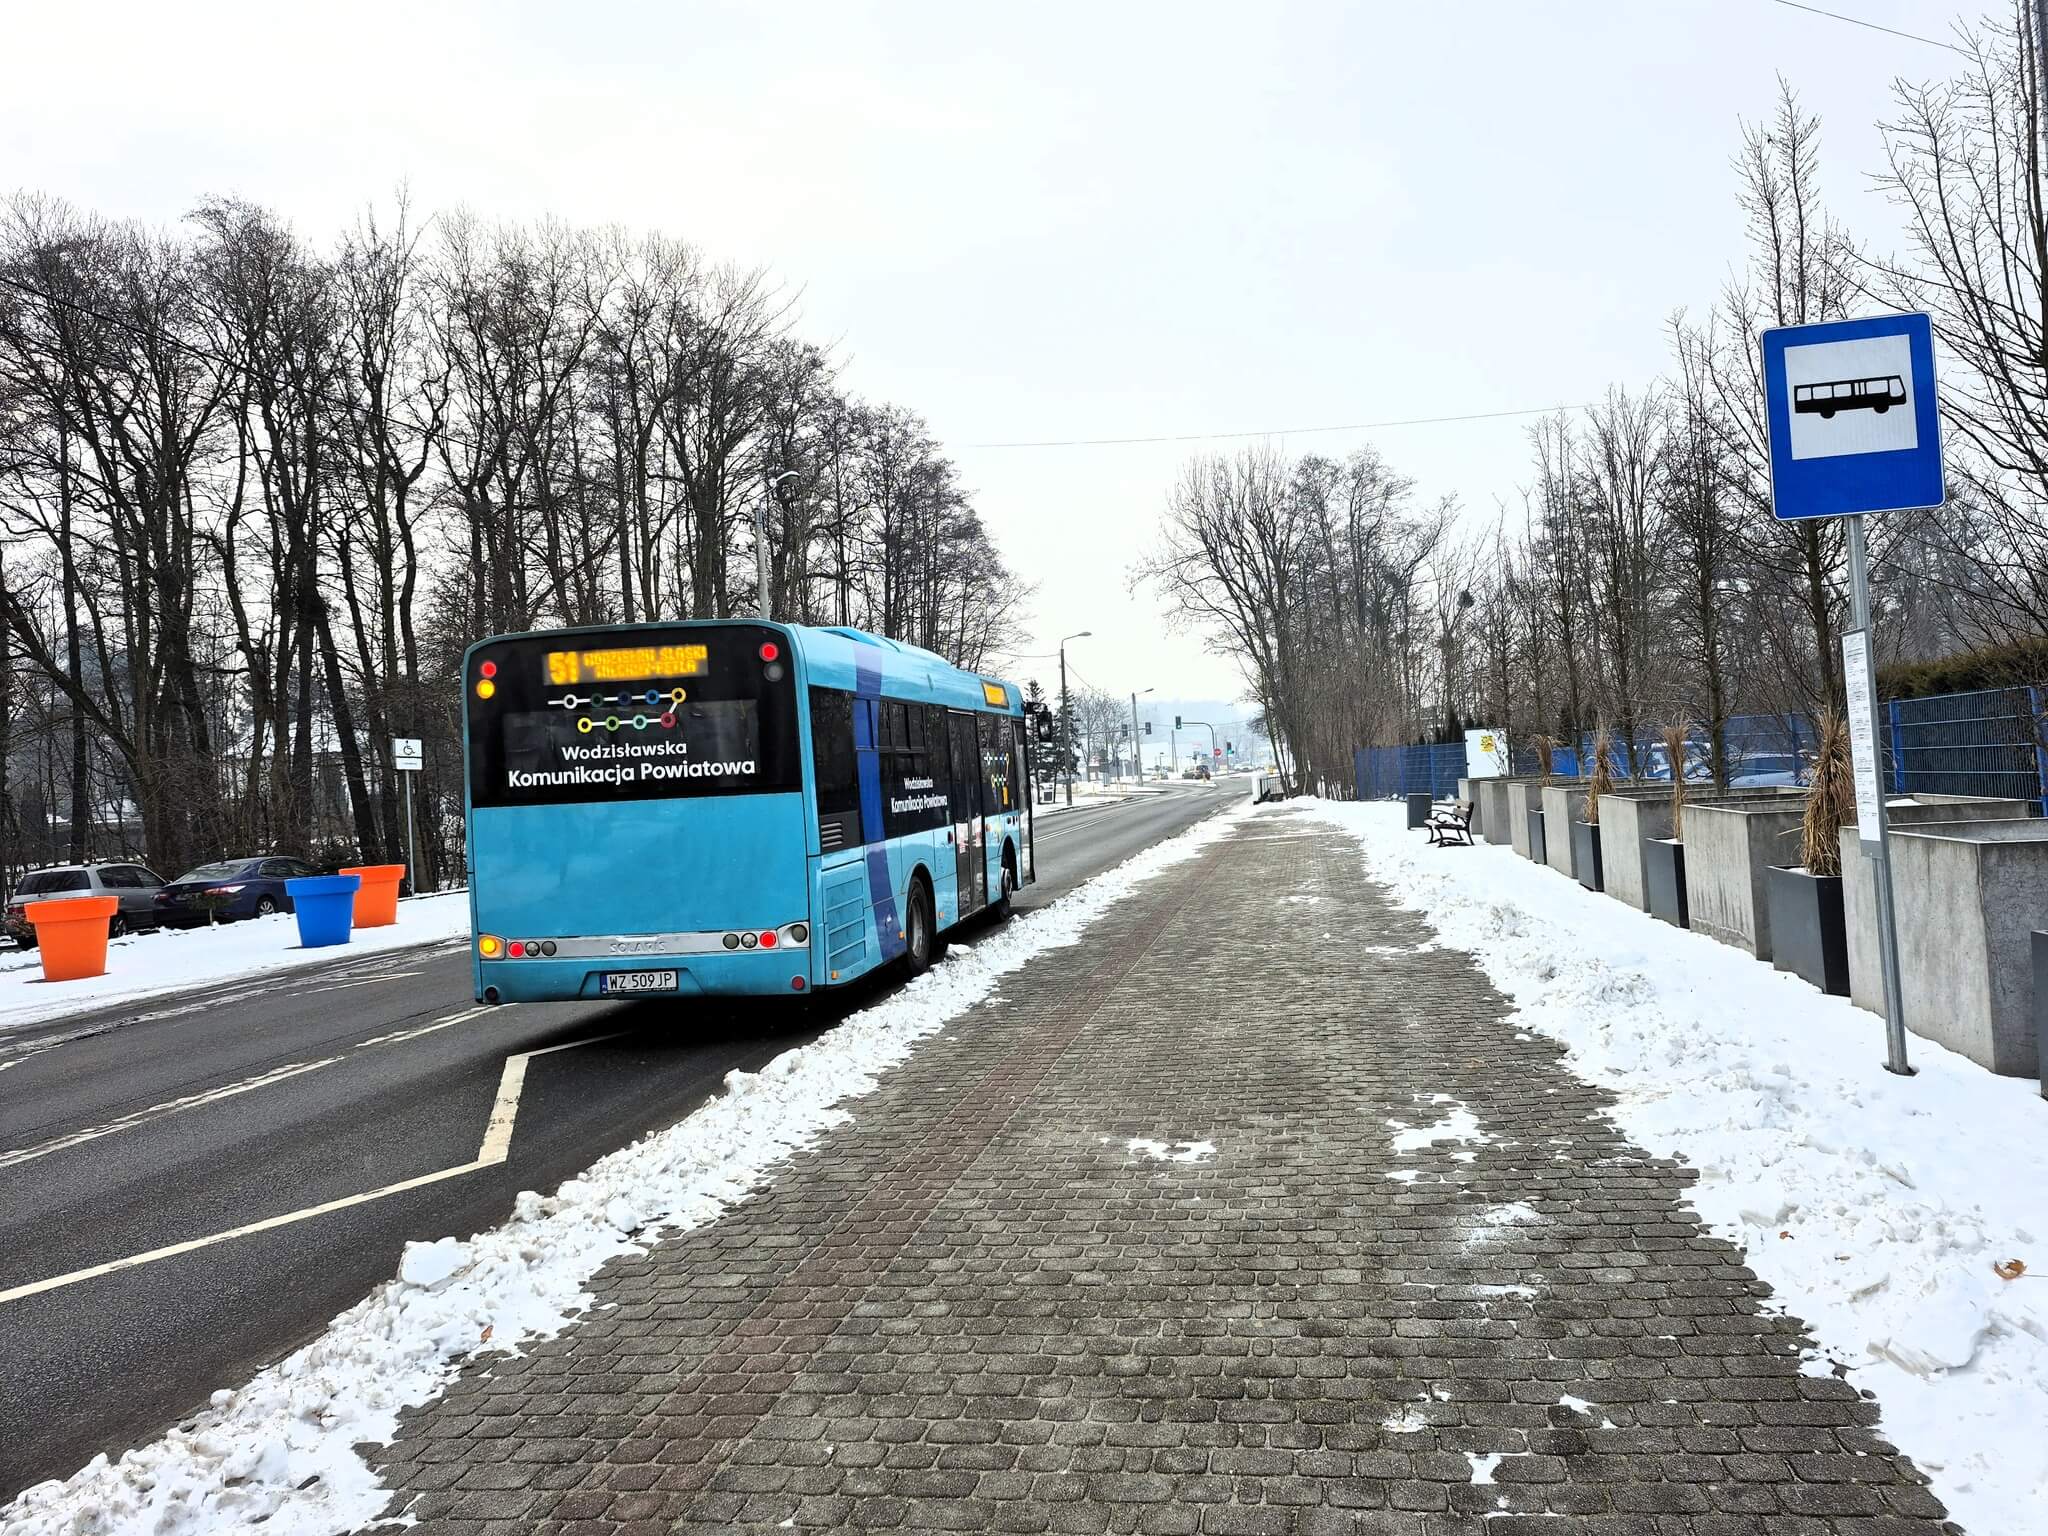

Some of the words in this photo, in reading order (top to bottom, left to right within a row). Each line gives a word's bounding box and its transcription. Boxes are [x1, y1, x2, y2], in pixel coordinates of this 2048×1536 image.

[548, 651, 579, 685] 51
[561, 740, 688, 761] Wodzisławska
[508, 765, 635, 787] Komunikacja
[640, 760, 756, 780] Powiatowa
[609, 941, 666, 954] SOLARIS
[609, 975, 627, 989] WZ
